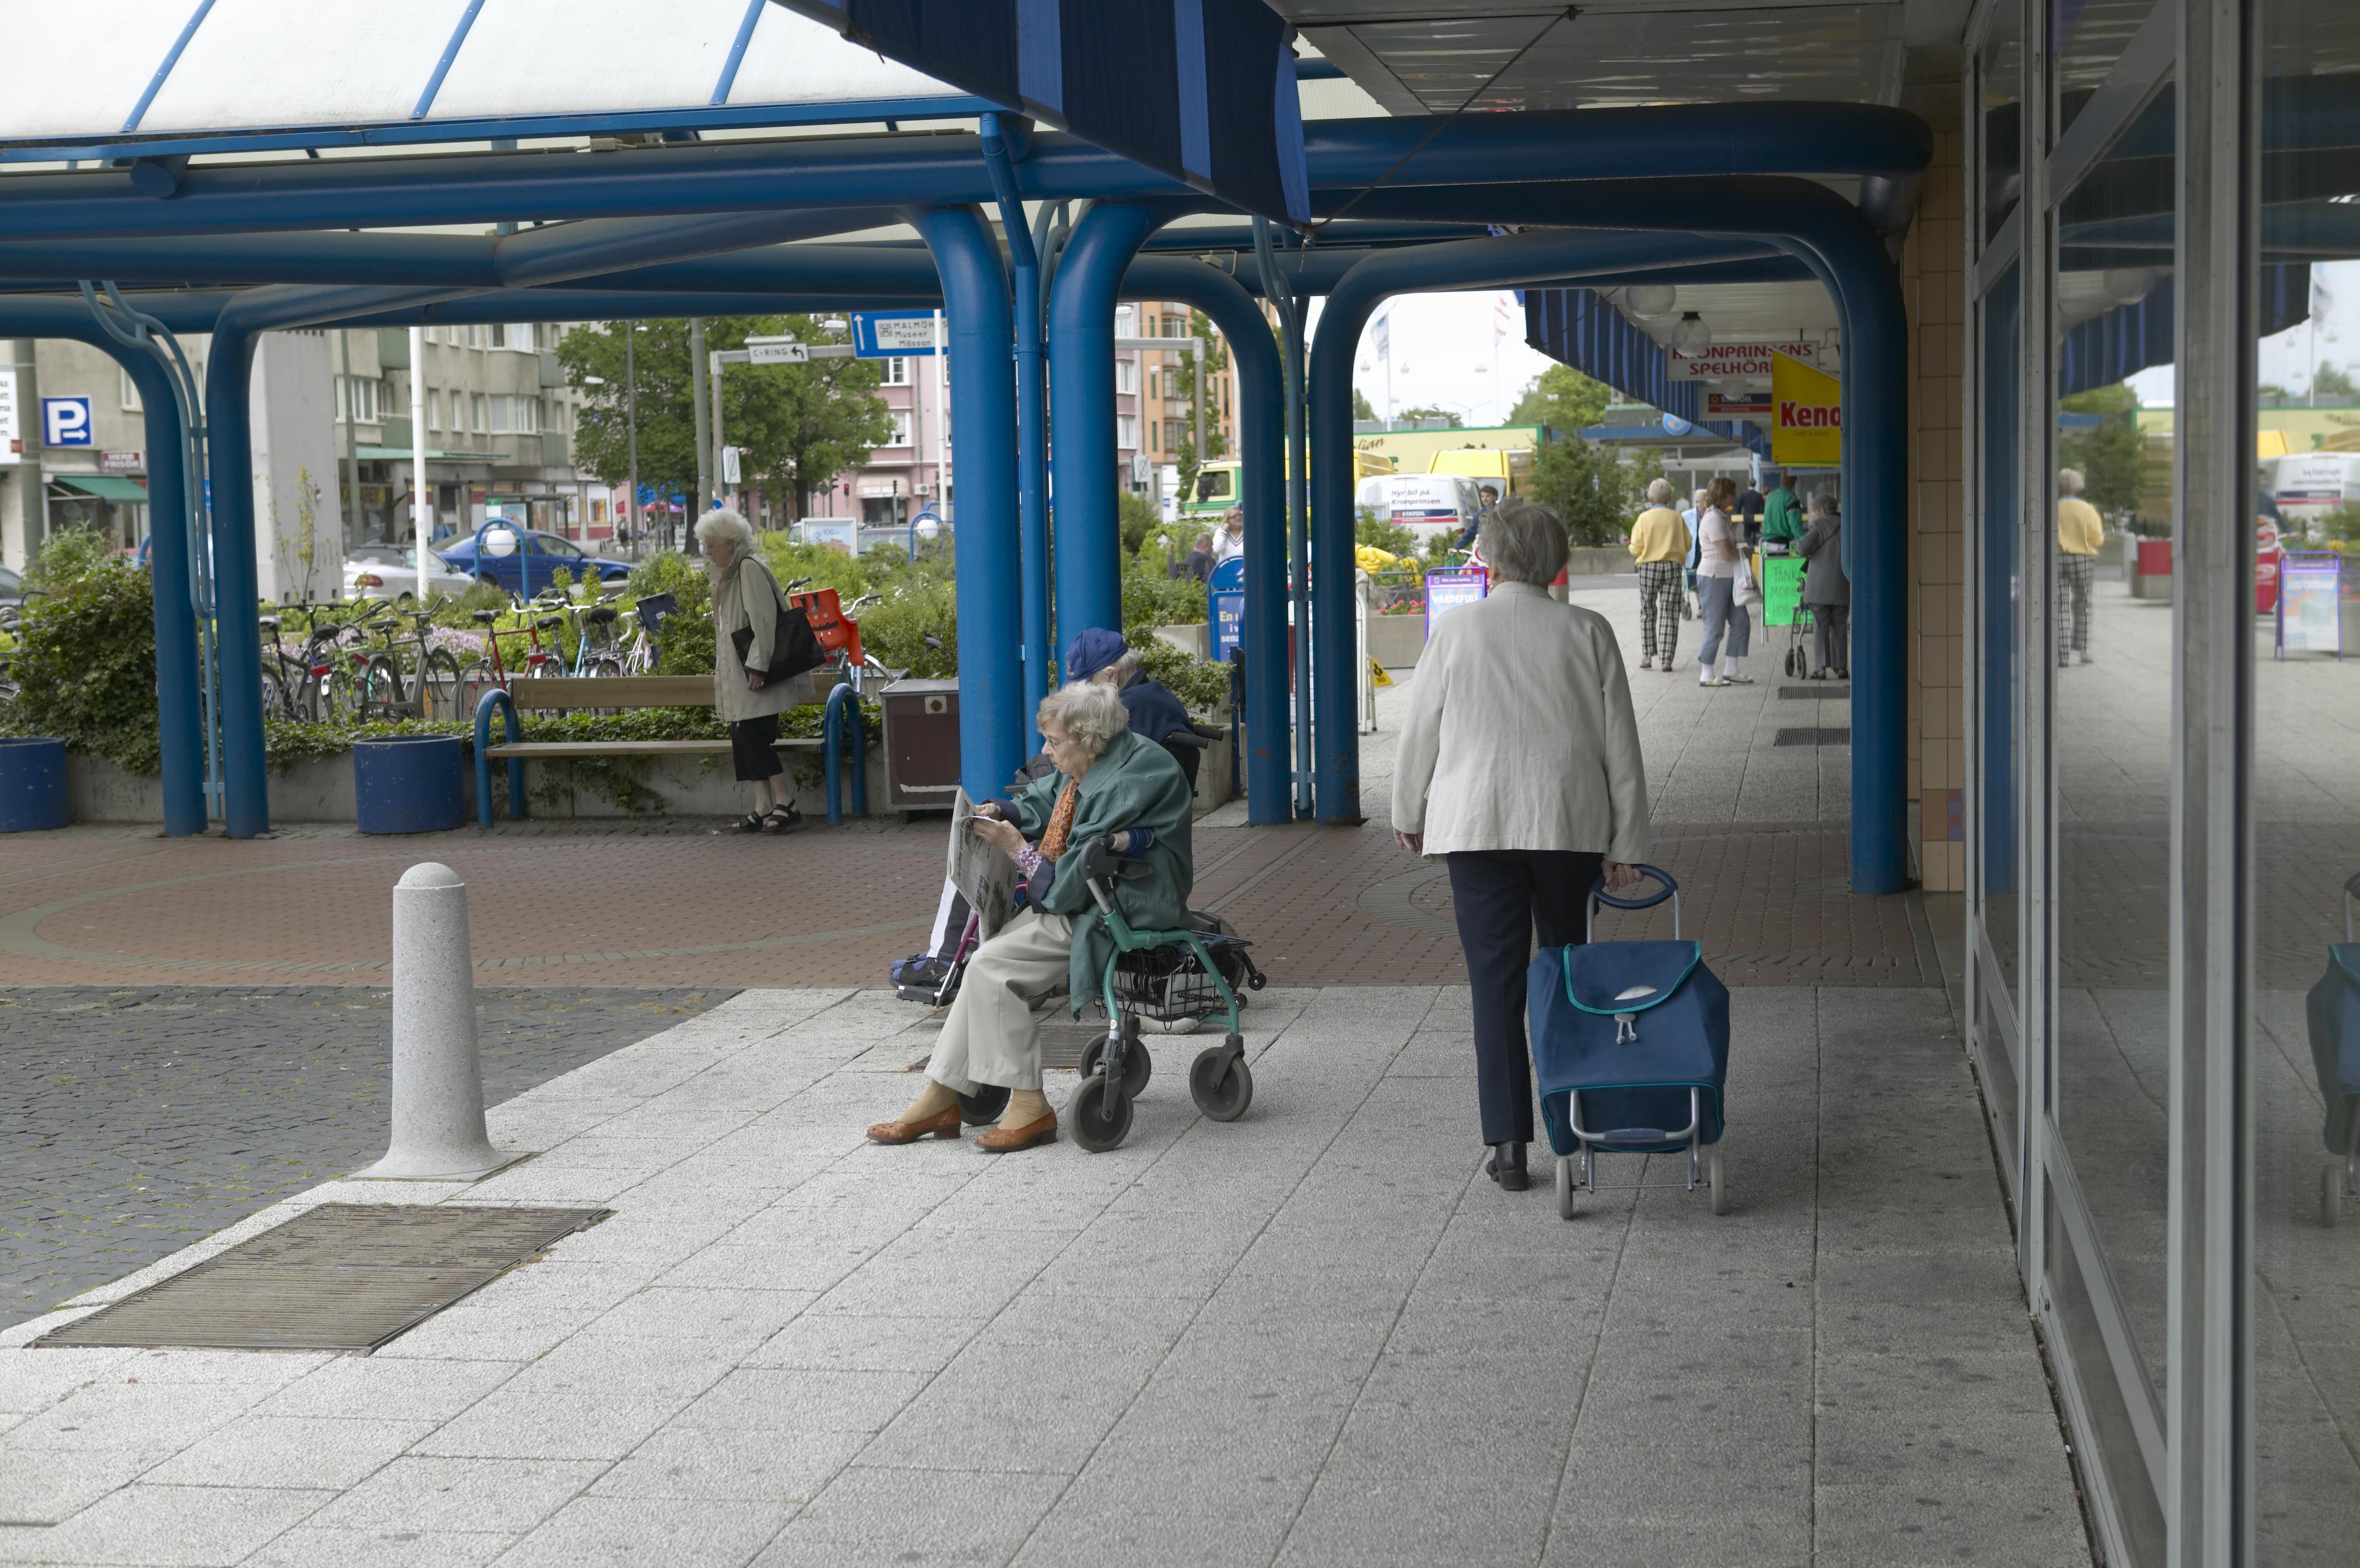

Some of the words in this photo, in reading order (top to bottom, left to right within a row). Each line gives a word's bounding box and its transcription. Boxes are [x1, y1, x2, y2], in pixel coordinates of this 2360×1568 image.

[893, 320, 948, 330] MALMÖHS
[753, 348, 788, 357] C-RING
[1672, 344, 1812, 360] KONPRINENS
[1689, 359, 1772, 375] SPELHÖR
[1720, 395, 1752, 404] SOIL
[1780, 401, 1841, 427] Keno
[47, 401, 87, 444] P
[1219, 611, 1233, 622] En
